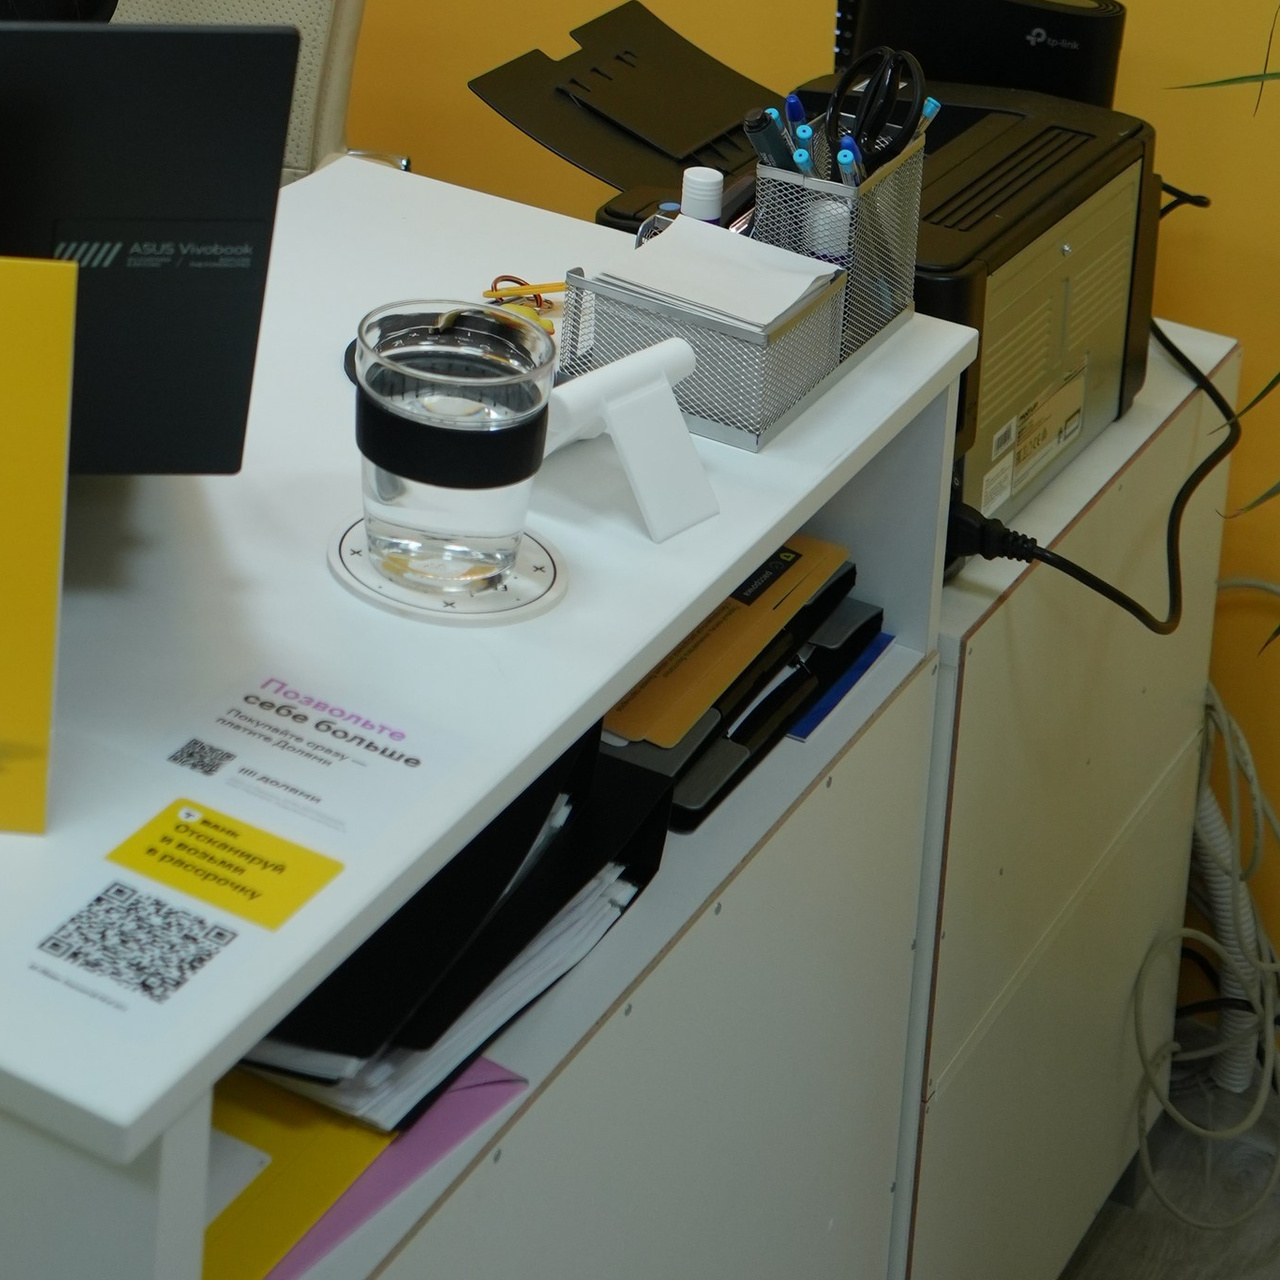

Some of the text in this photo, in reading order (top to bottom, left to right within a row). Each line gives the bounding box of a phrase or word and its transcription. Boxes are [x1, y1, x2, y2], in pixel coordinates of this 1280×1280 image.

[127, 241, 175, 257] ASUS
[226, 707, 351, 762] Покупайте сразу
[243, 693, 423, 769] себе больше
[259, 677, 408, 741] Позвольте
[216, 716, 334, 768] платите Долями
[146, 846, 263, 902] в рассрочку
[159, 835, 247, 877] и возьми
[174, 823, 288, 875] Отсканируй
